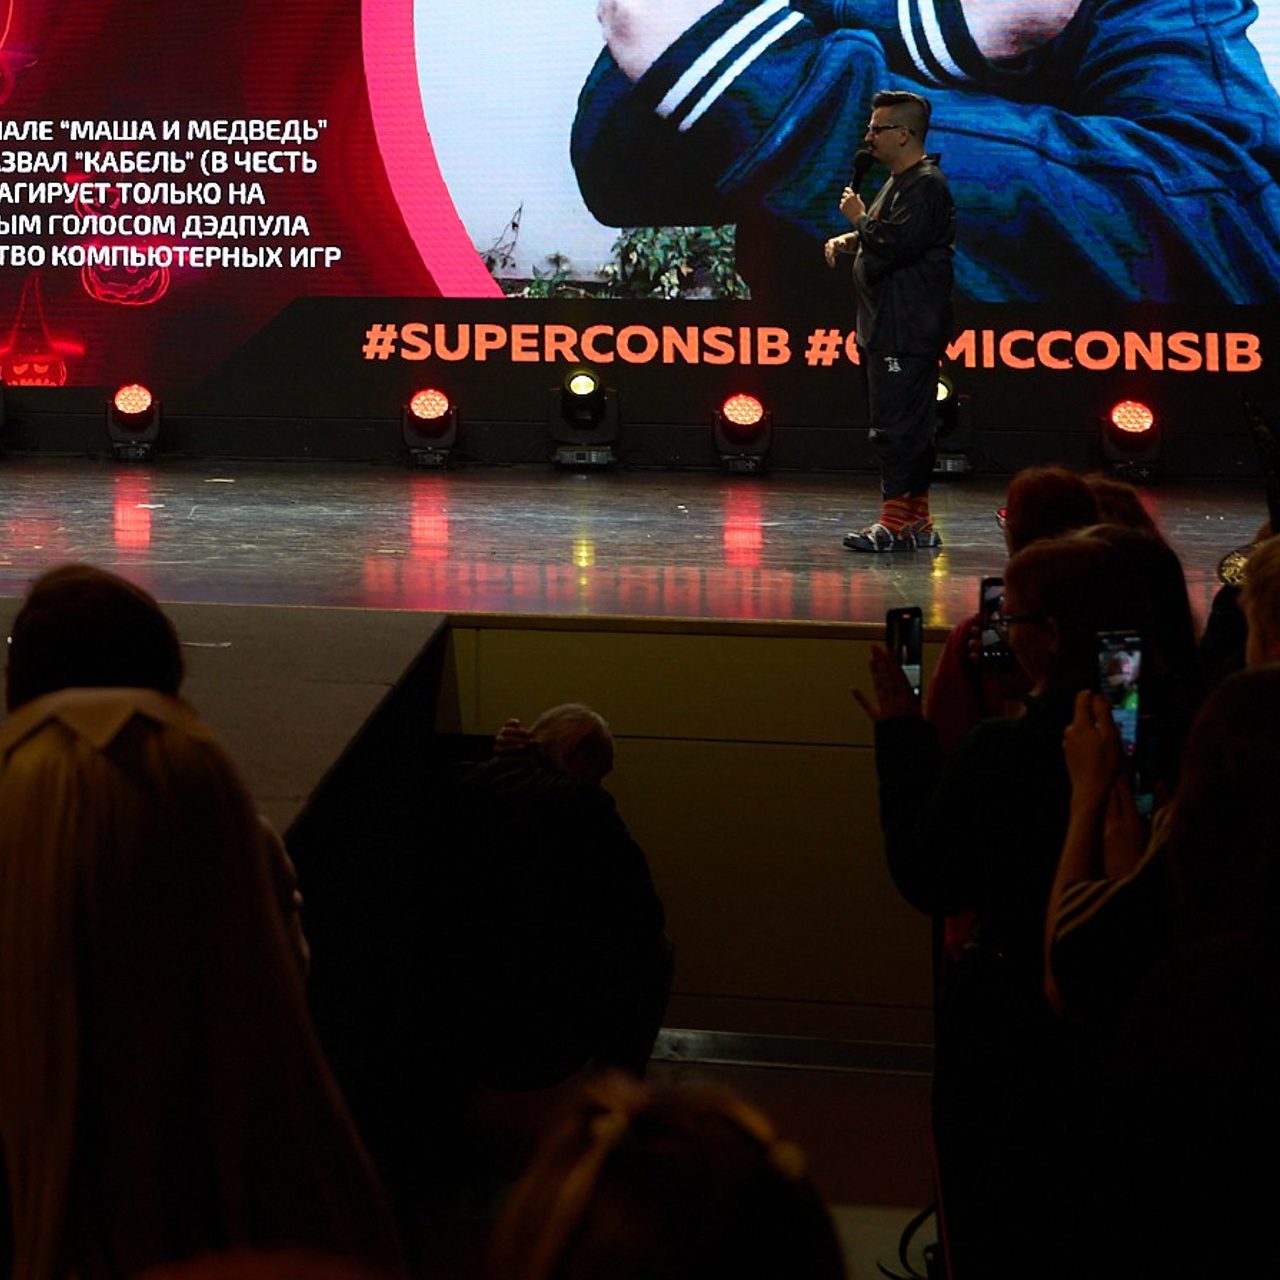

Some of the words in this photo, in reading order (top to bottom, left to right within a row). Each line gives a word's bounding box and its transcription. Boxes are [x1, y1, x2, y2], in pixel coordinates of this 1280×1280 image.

[162, 120, 180, 141] И
[200, 149, 229, 177] (В
[234, 150, 317, 174] ЧЕСТЬ
[115, 182, 222, 205] ТОЛЬКО
[228, 182, 266, 205] НА
[48, 214, 176, 236] ГОЛОСОМ
[181, 215, 310, 240] ДЭДПУЛА
[51, 245, 283, 268] КОМПЬЮТЕРНЫХ
[290, 246, 342, 268] ИГР
[361, 323, 792, 365] #SUPERCONSIB
[805, 328, 1263, 372] #MICCONSIB
